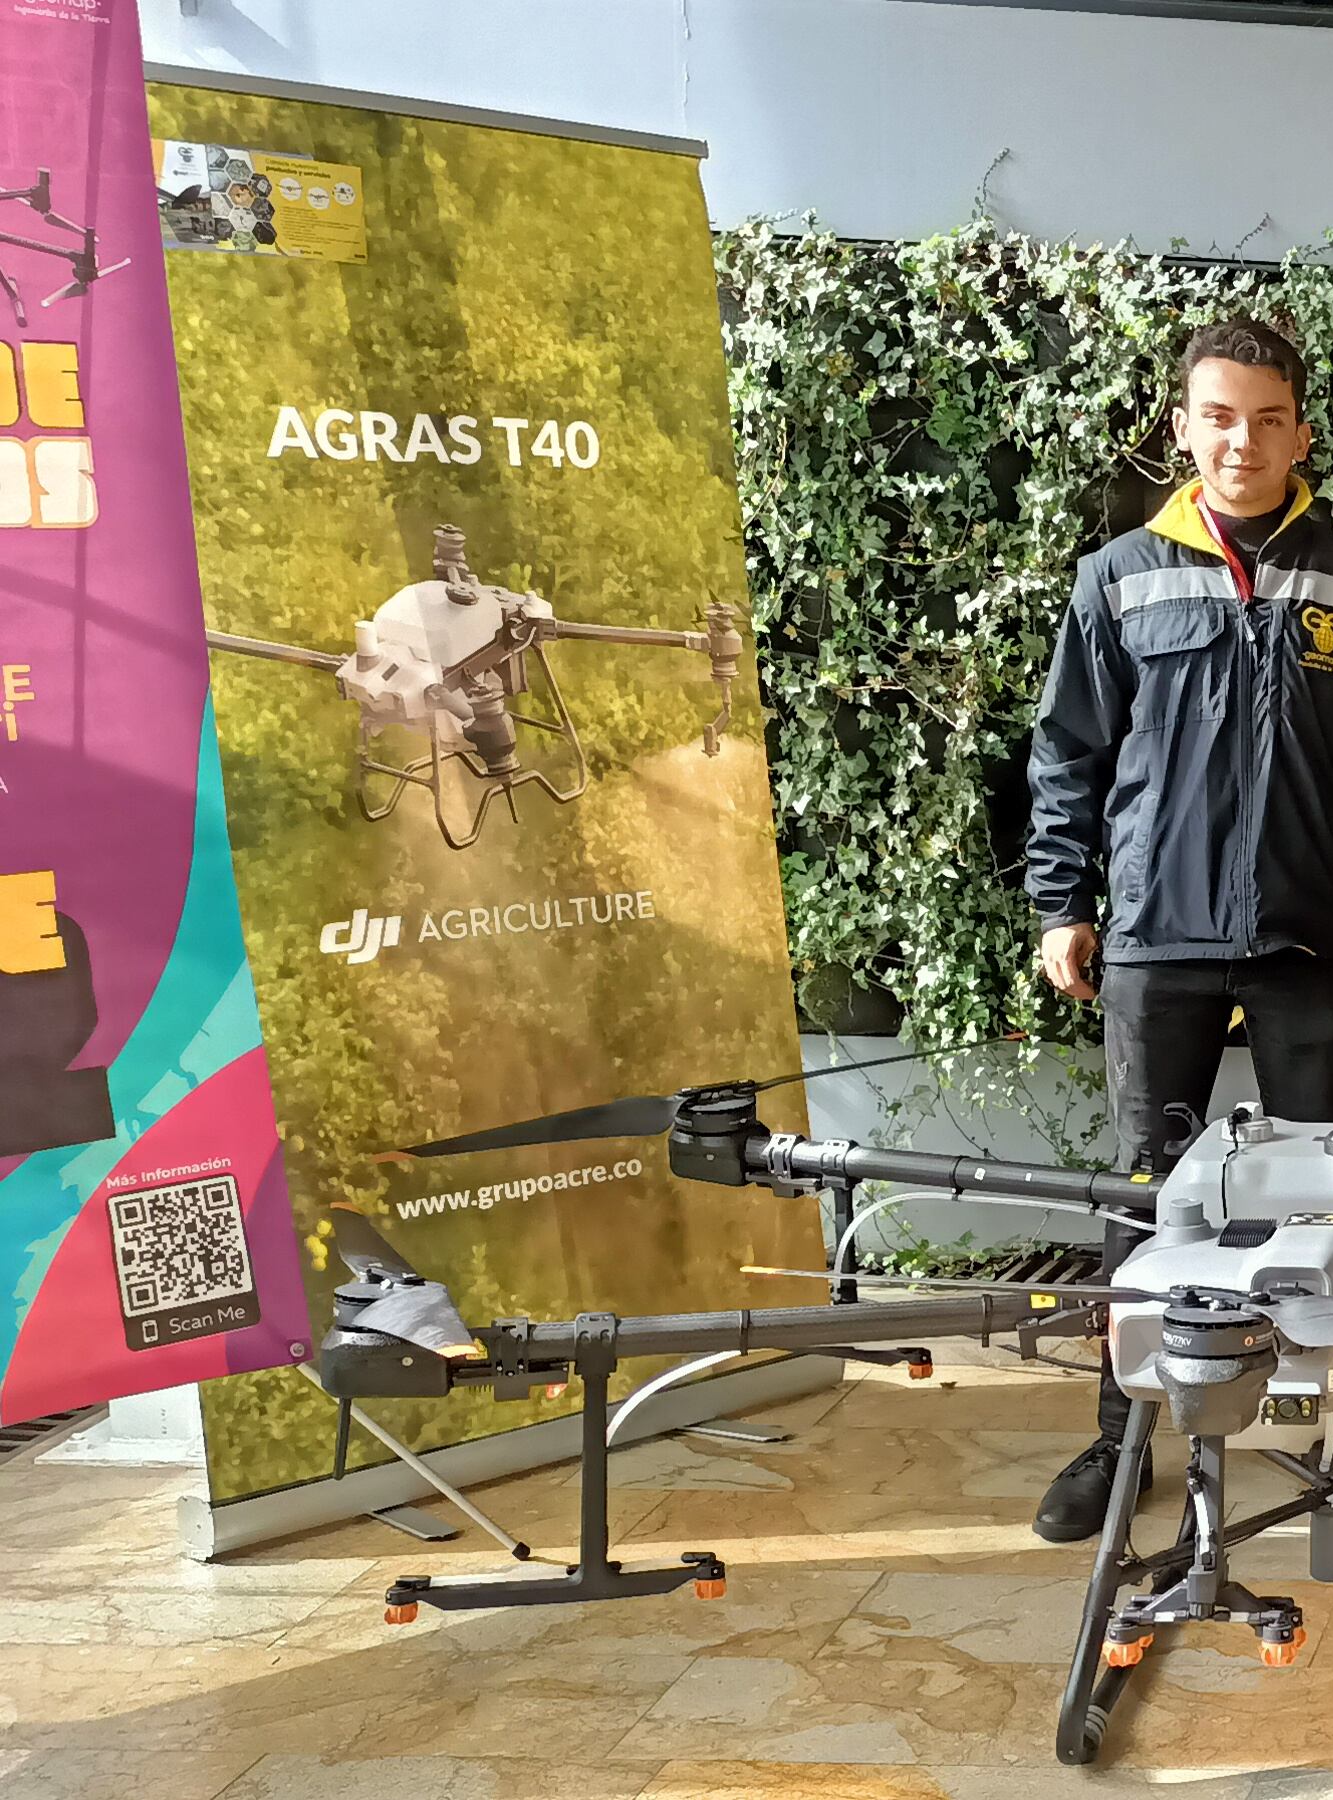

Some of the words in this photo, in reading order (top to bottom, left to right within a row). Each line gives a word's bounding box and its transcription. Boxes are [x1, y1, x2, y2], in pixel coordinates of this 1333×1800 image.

[266, 406, 482, 465] AGRAS
[492, 417, 600, 469] T40
[418, 890, 655, 943] AGRICULTURE
[105, 1173, 137, 1189] Más
[141, 1156, 232, 1182] Información
[396, 1158, 642, 1220] www.grupoacre.co
[169, 1313, 213, 1334] Scan
[217, 1306, 246, 1324] Me
